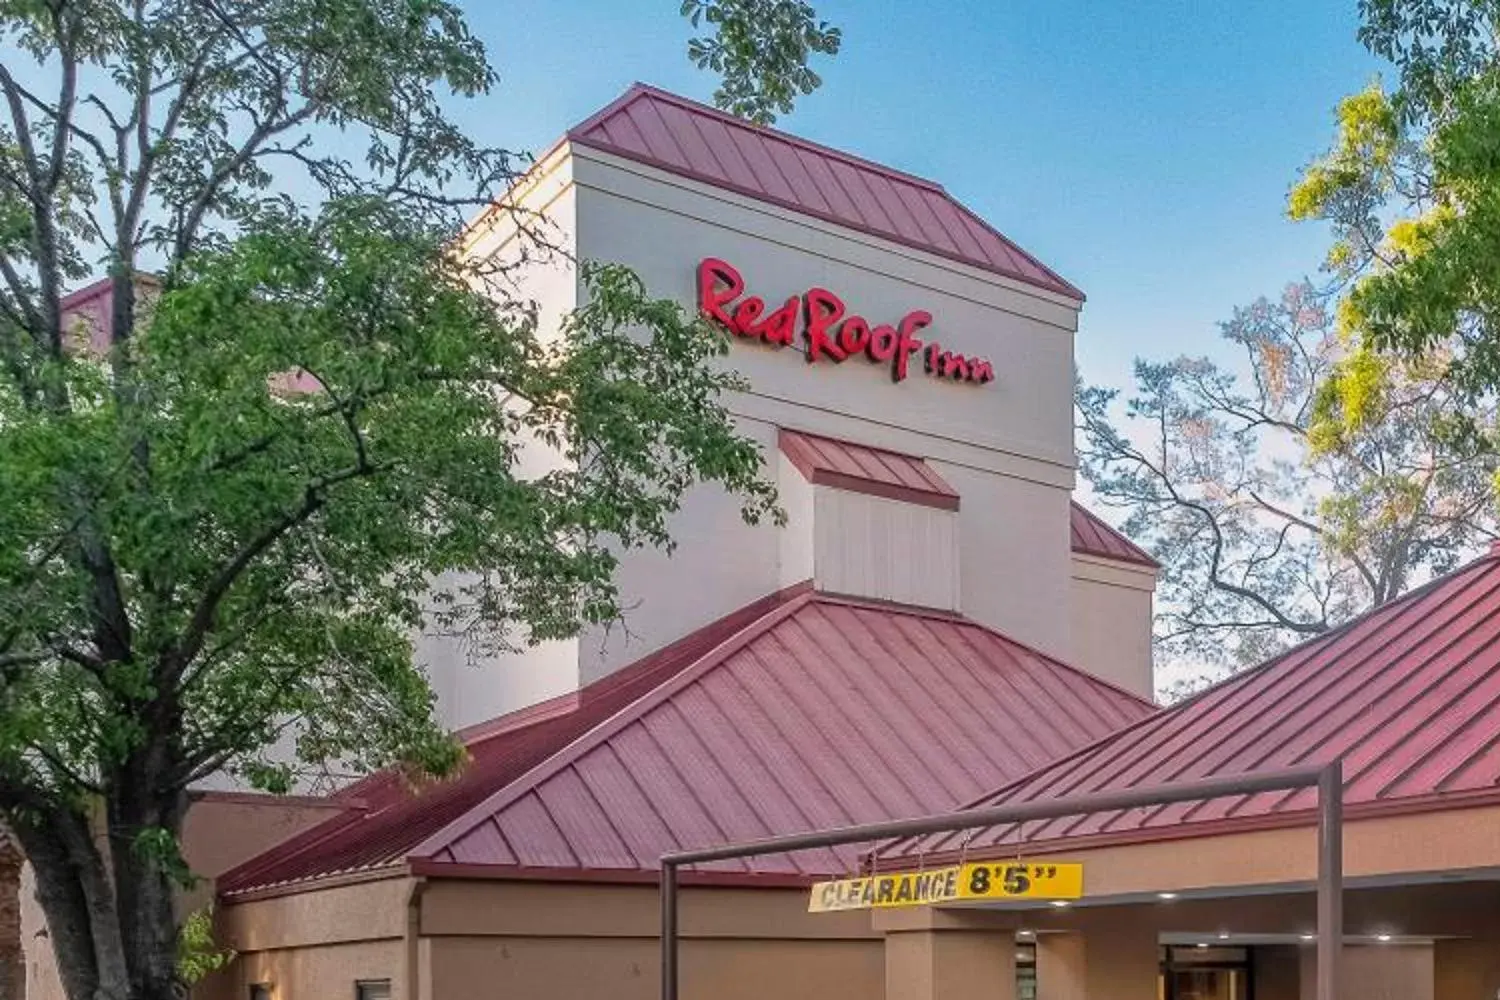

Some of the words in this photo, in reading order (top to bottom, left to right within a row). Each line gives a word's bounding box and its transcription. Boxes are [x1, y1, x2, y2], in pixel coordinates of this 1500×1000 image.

[697, 257, 799, 347] Red
[803, 288, 932, 383] Roof
[821, 870, 956, 903] CLEARANCE
